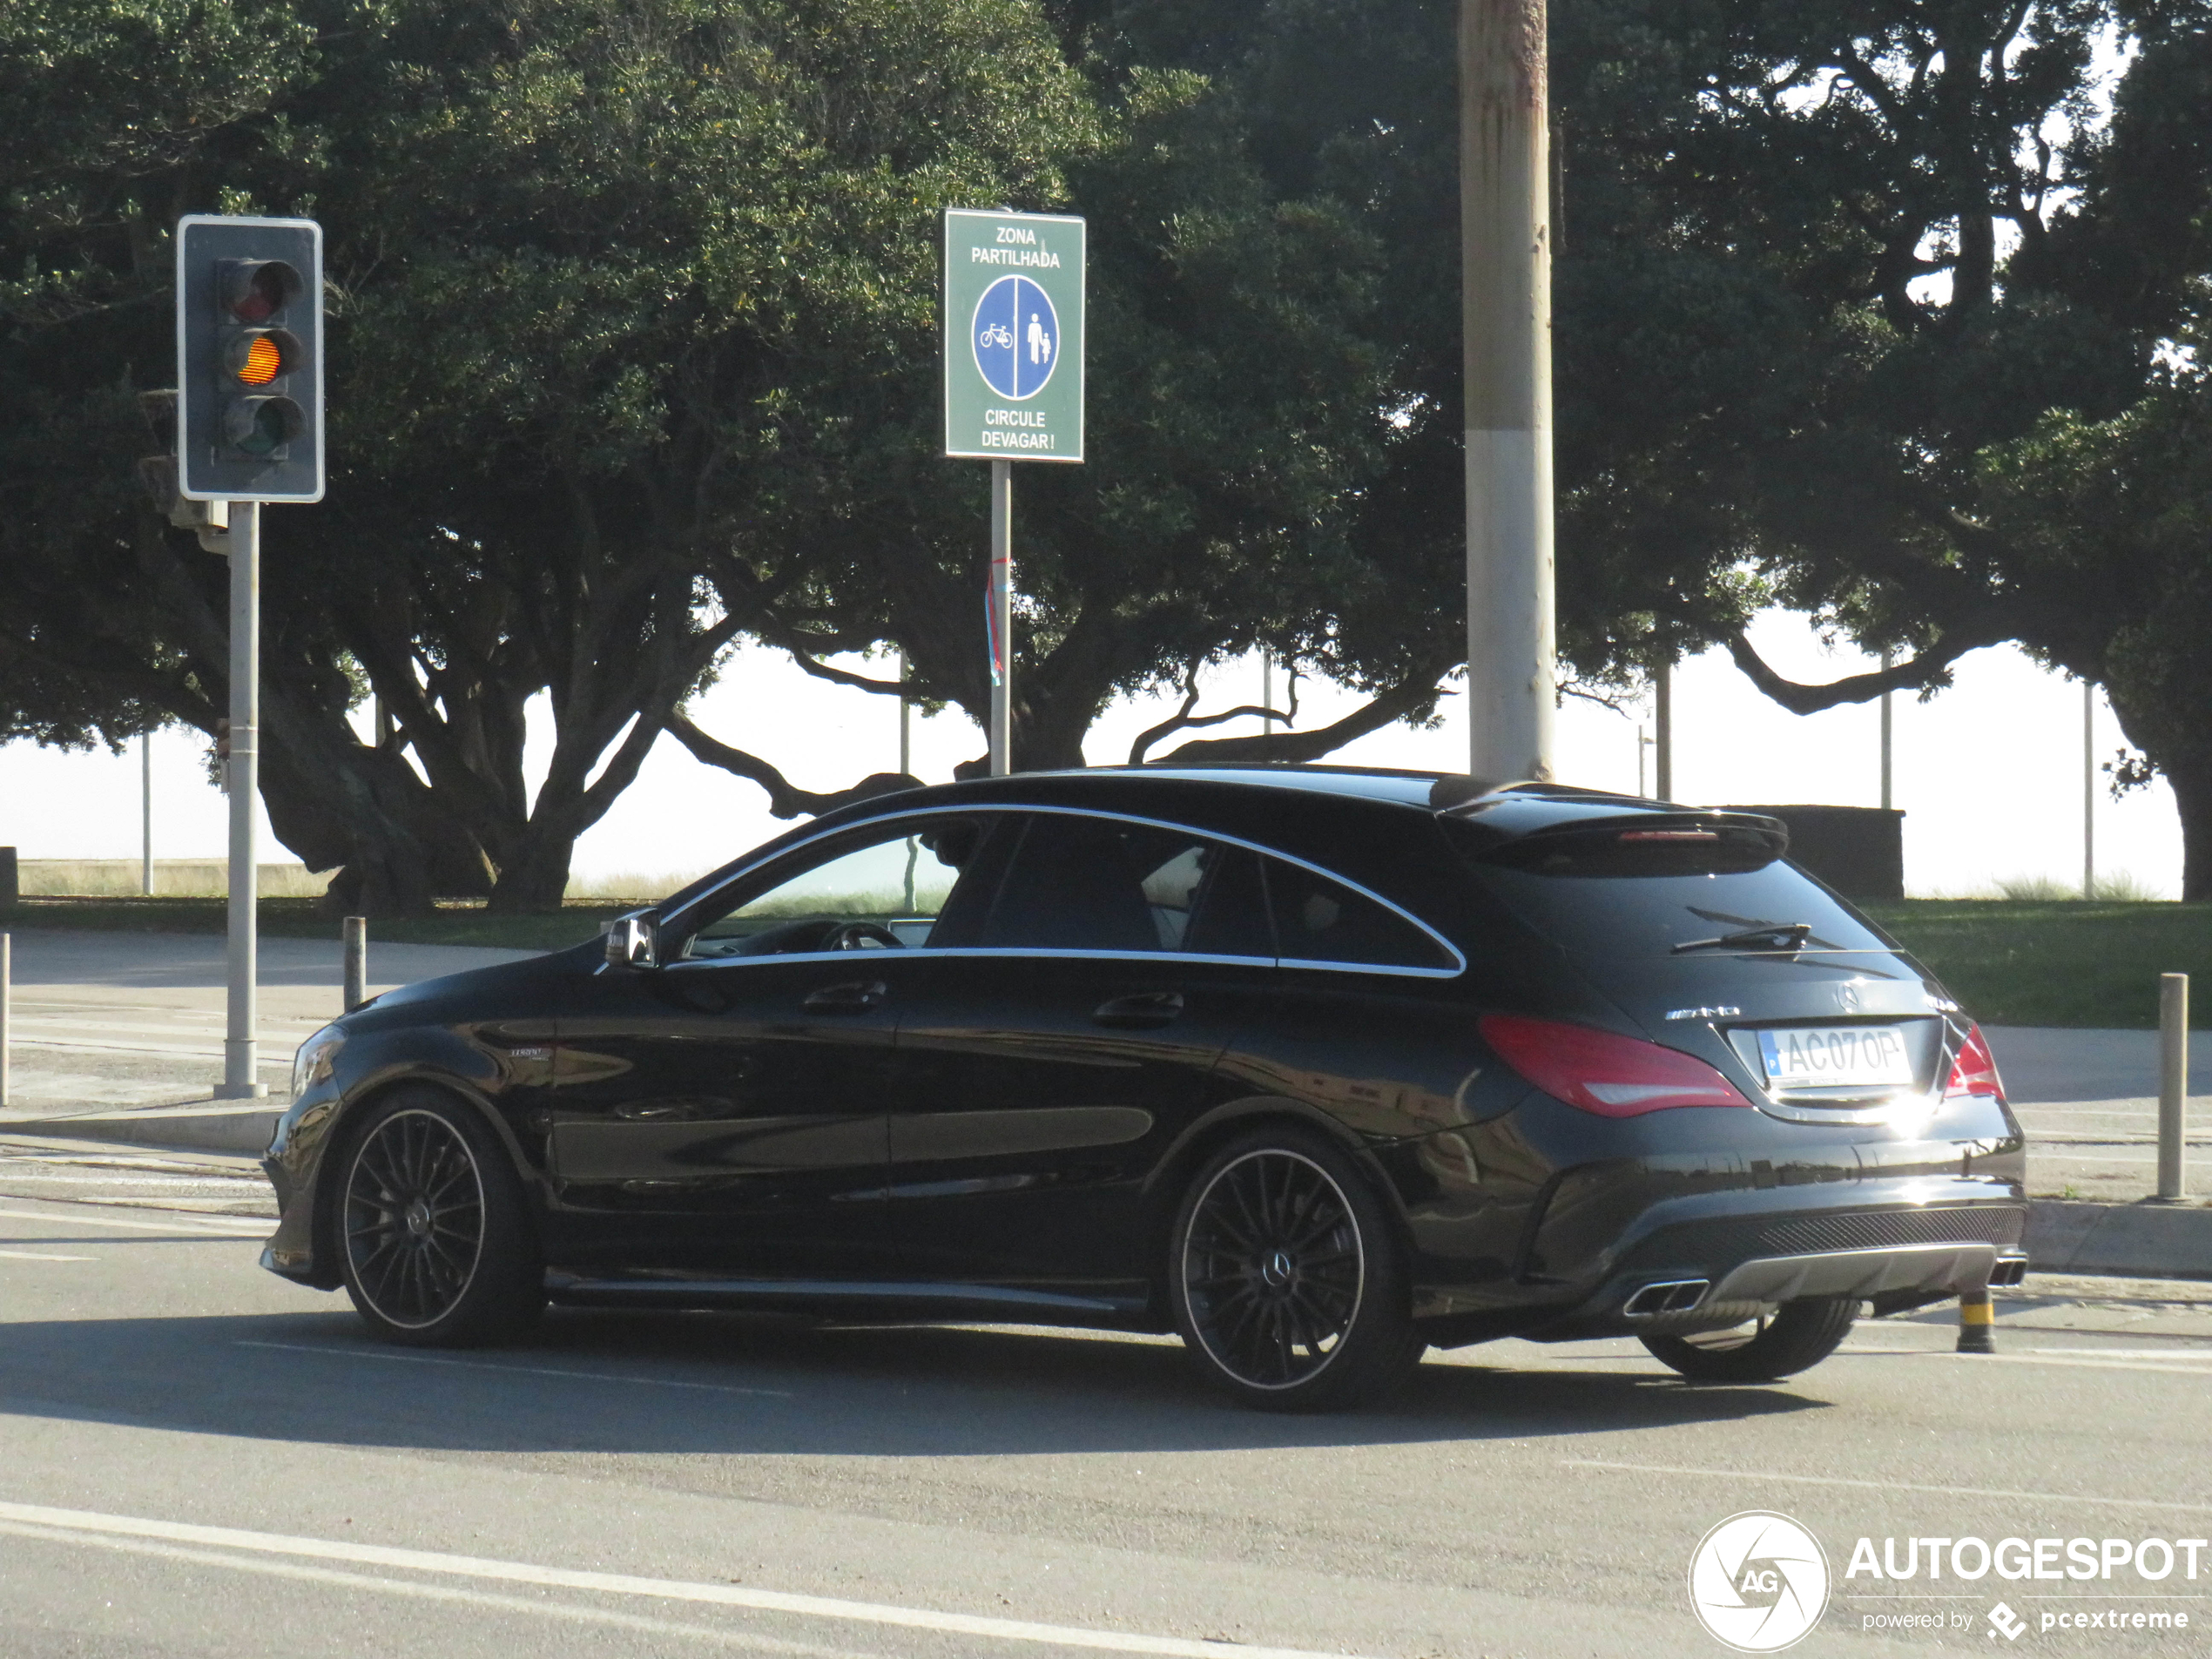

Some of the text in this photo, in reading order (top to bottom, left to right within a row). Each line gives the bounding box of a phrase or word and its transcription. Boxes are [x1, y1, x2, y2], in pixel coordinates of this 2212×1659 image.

[996, 227, 1036, 245] ZONA
[971, 247, 1060, 268] PARTILHADA
[985, 409, 1046, 428] CIRCULE
[981, 431, 1055, 449] DEVAGAR!
[1769, 1059, 1777, 1069] P
